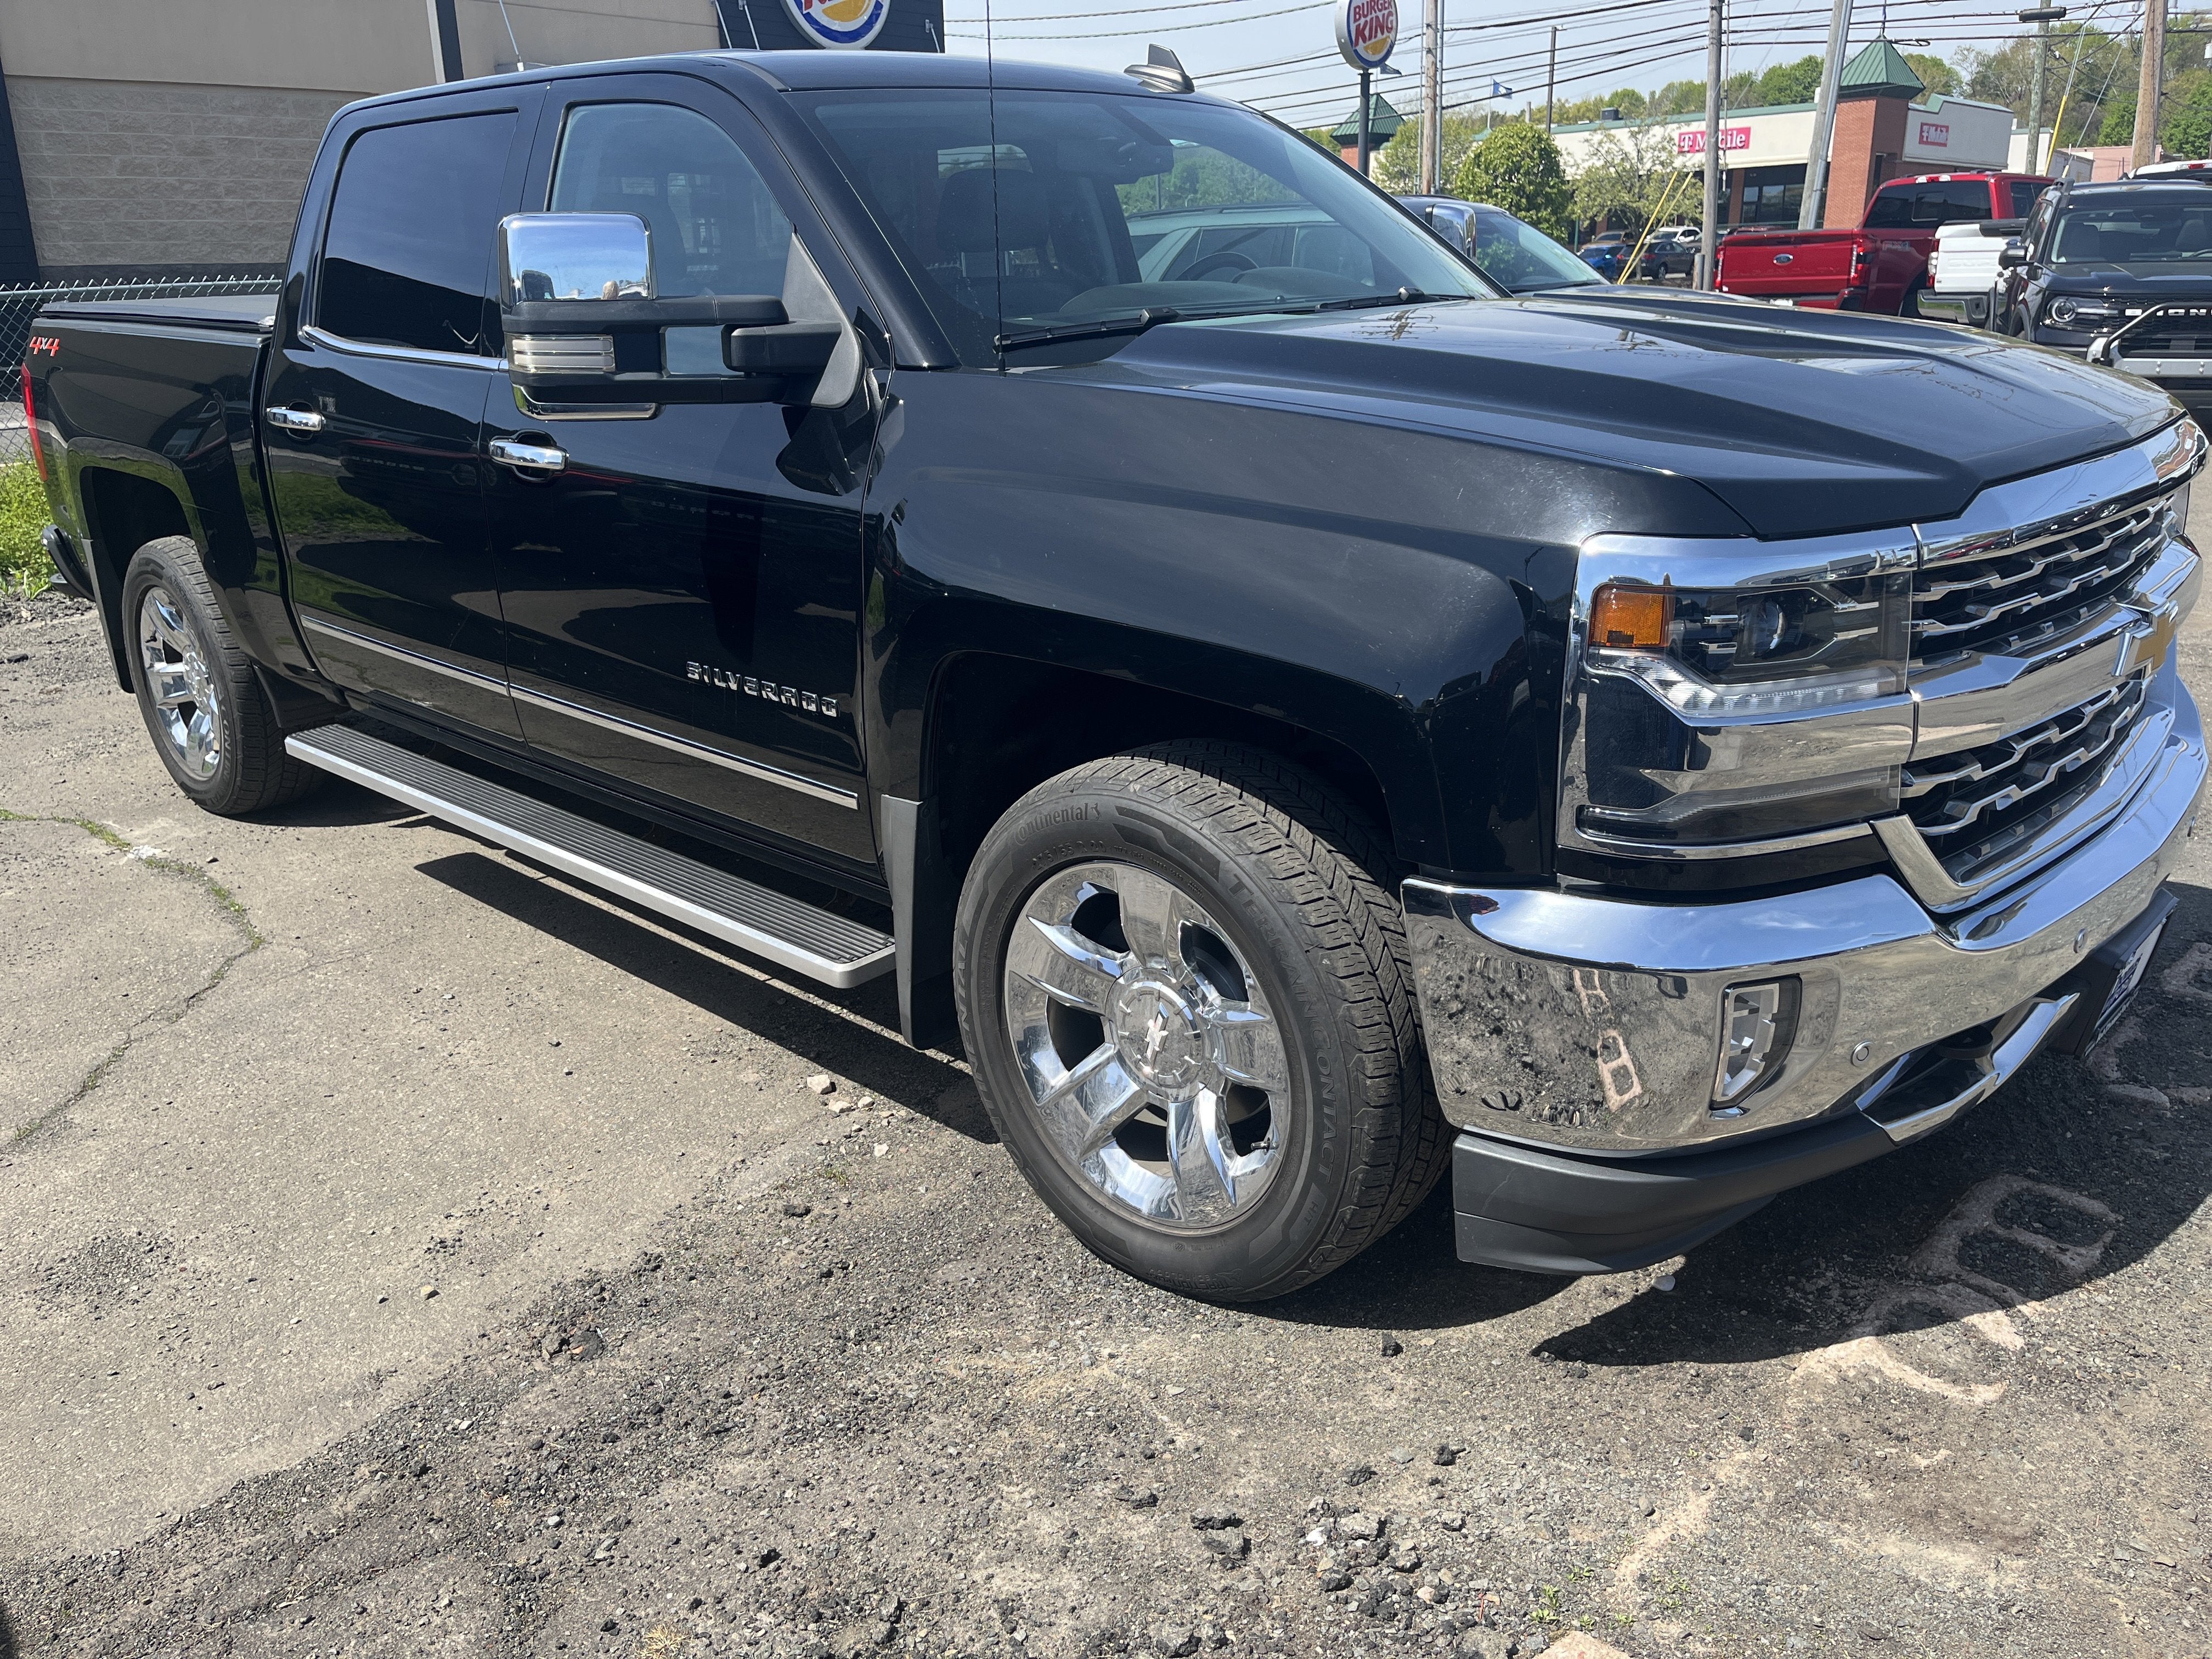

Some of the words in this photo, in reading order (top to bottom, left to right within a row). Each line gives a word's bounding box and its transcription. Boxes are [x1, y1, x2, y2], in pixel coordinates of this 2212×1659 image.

[1354, 11, 1393, 48] KING
[1695, 131, 1746, 151] Mbile
[686, 661, 840, 717] SILVERADO
[1015, 803, 1089, 845] Continental
